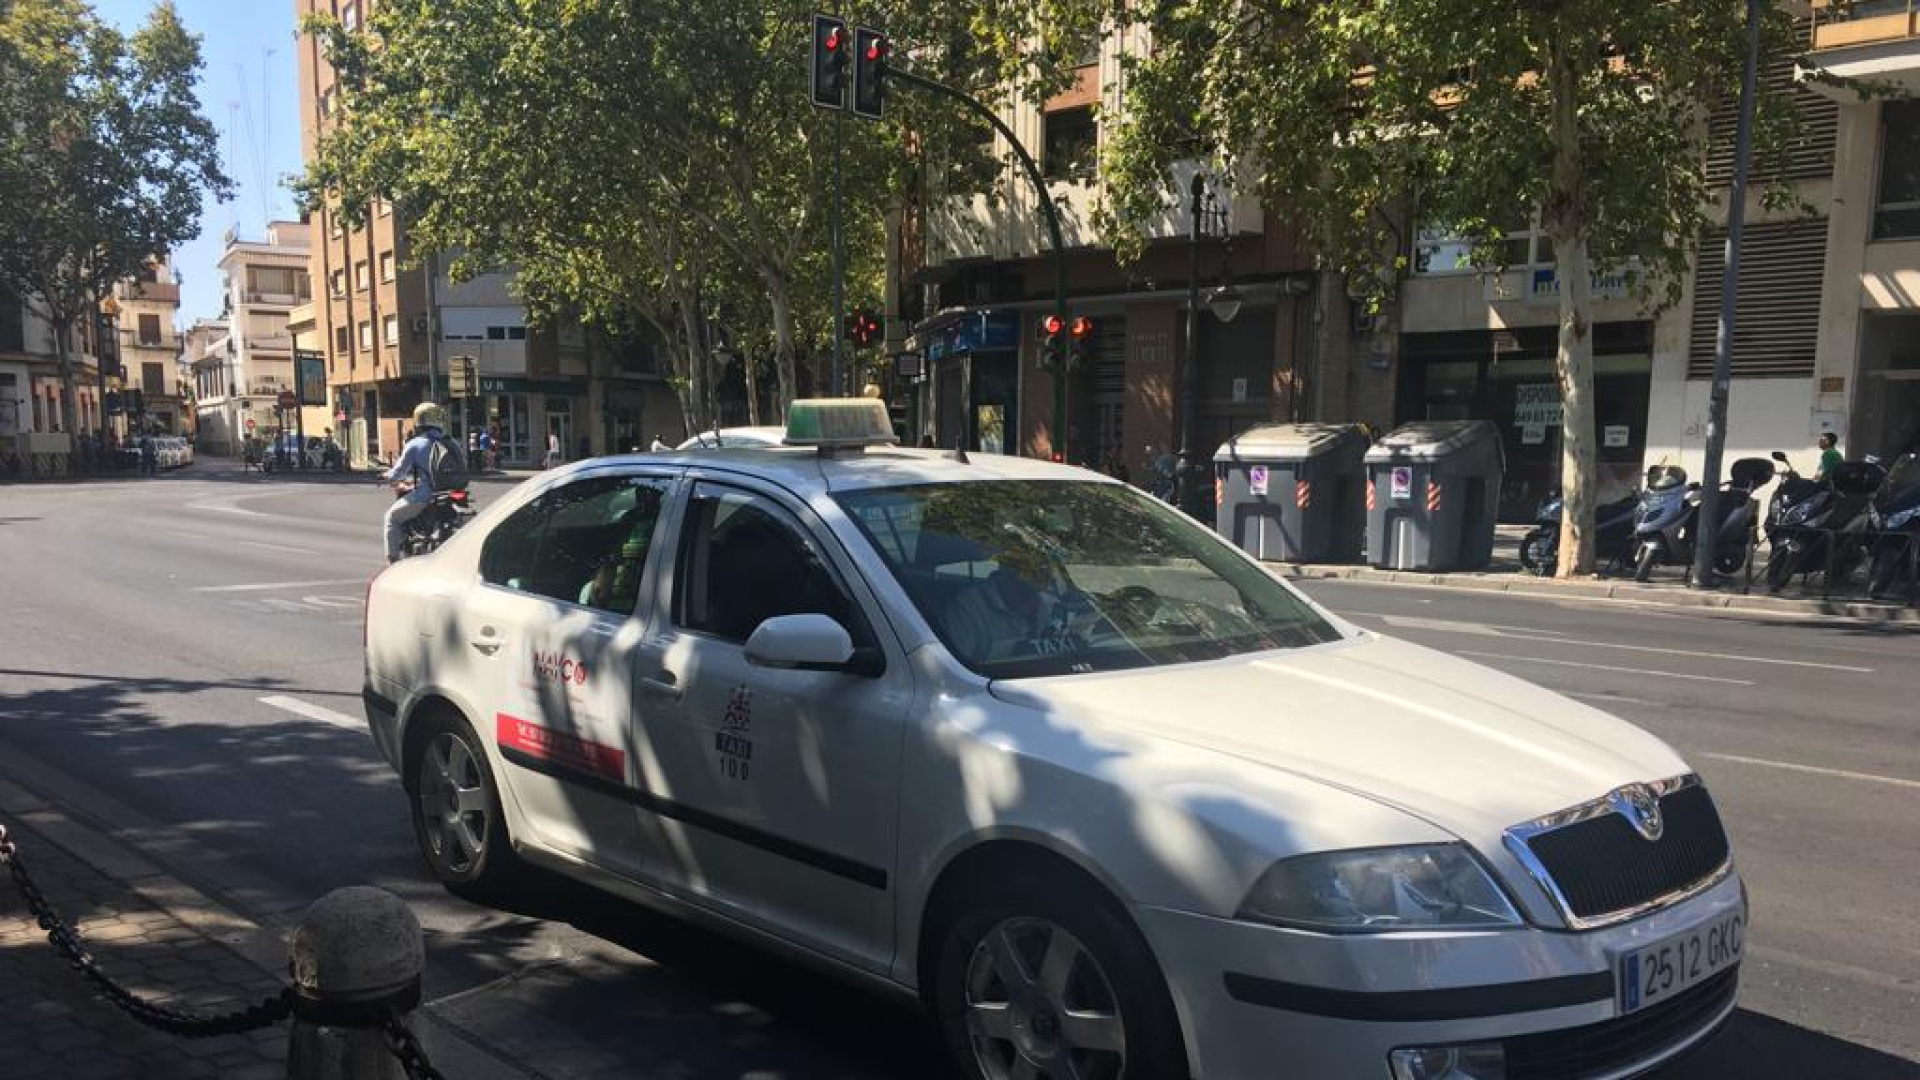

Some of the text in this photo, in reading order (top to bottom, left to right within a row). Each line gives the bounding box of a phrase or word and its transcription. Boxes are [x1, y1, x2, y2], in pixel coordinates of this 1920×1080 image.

[1029, 637, 1077, 656] TAXI
[1645, 915, 1742, 997] 2512 GKC
